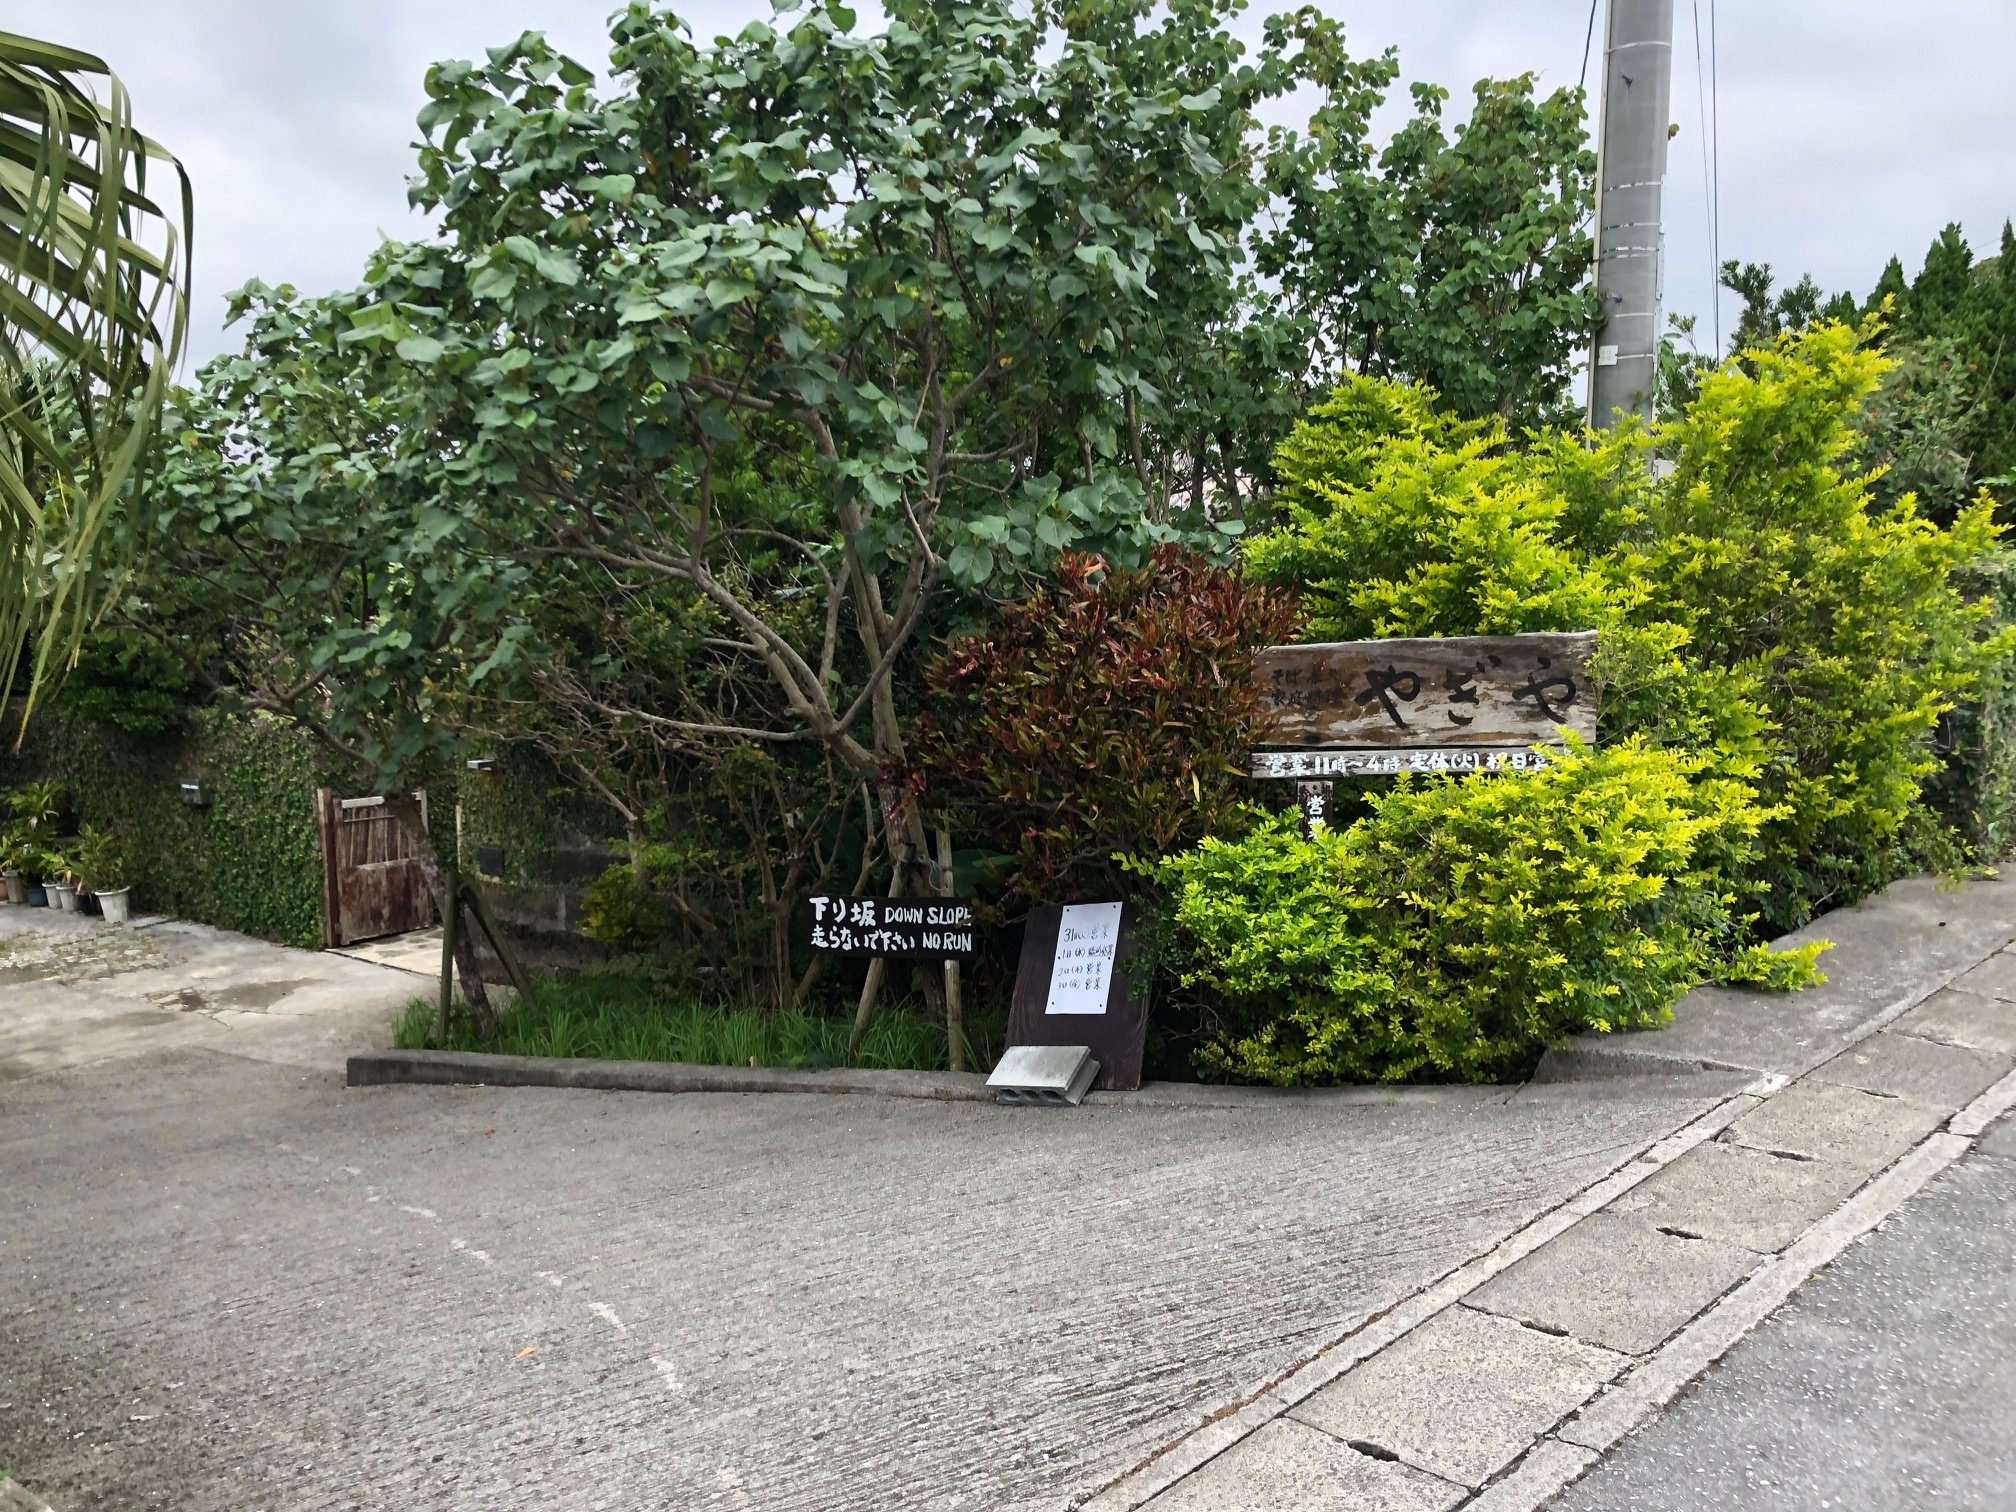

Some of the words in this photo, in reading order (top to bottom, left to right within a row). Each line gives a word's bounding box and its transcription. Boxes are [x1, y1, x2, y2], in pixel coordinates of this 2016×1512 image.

[1354, 654, 1577, 729] やぎや
[809, 897, 877, 926] 下り坂
[885, 907, 923, 924] DOWN
[811, 924, 916, 951] 走らないで下さい
[923, 931, 941, 950] NO
[943, 932, 972, 952] RUN
